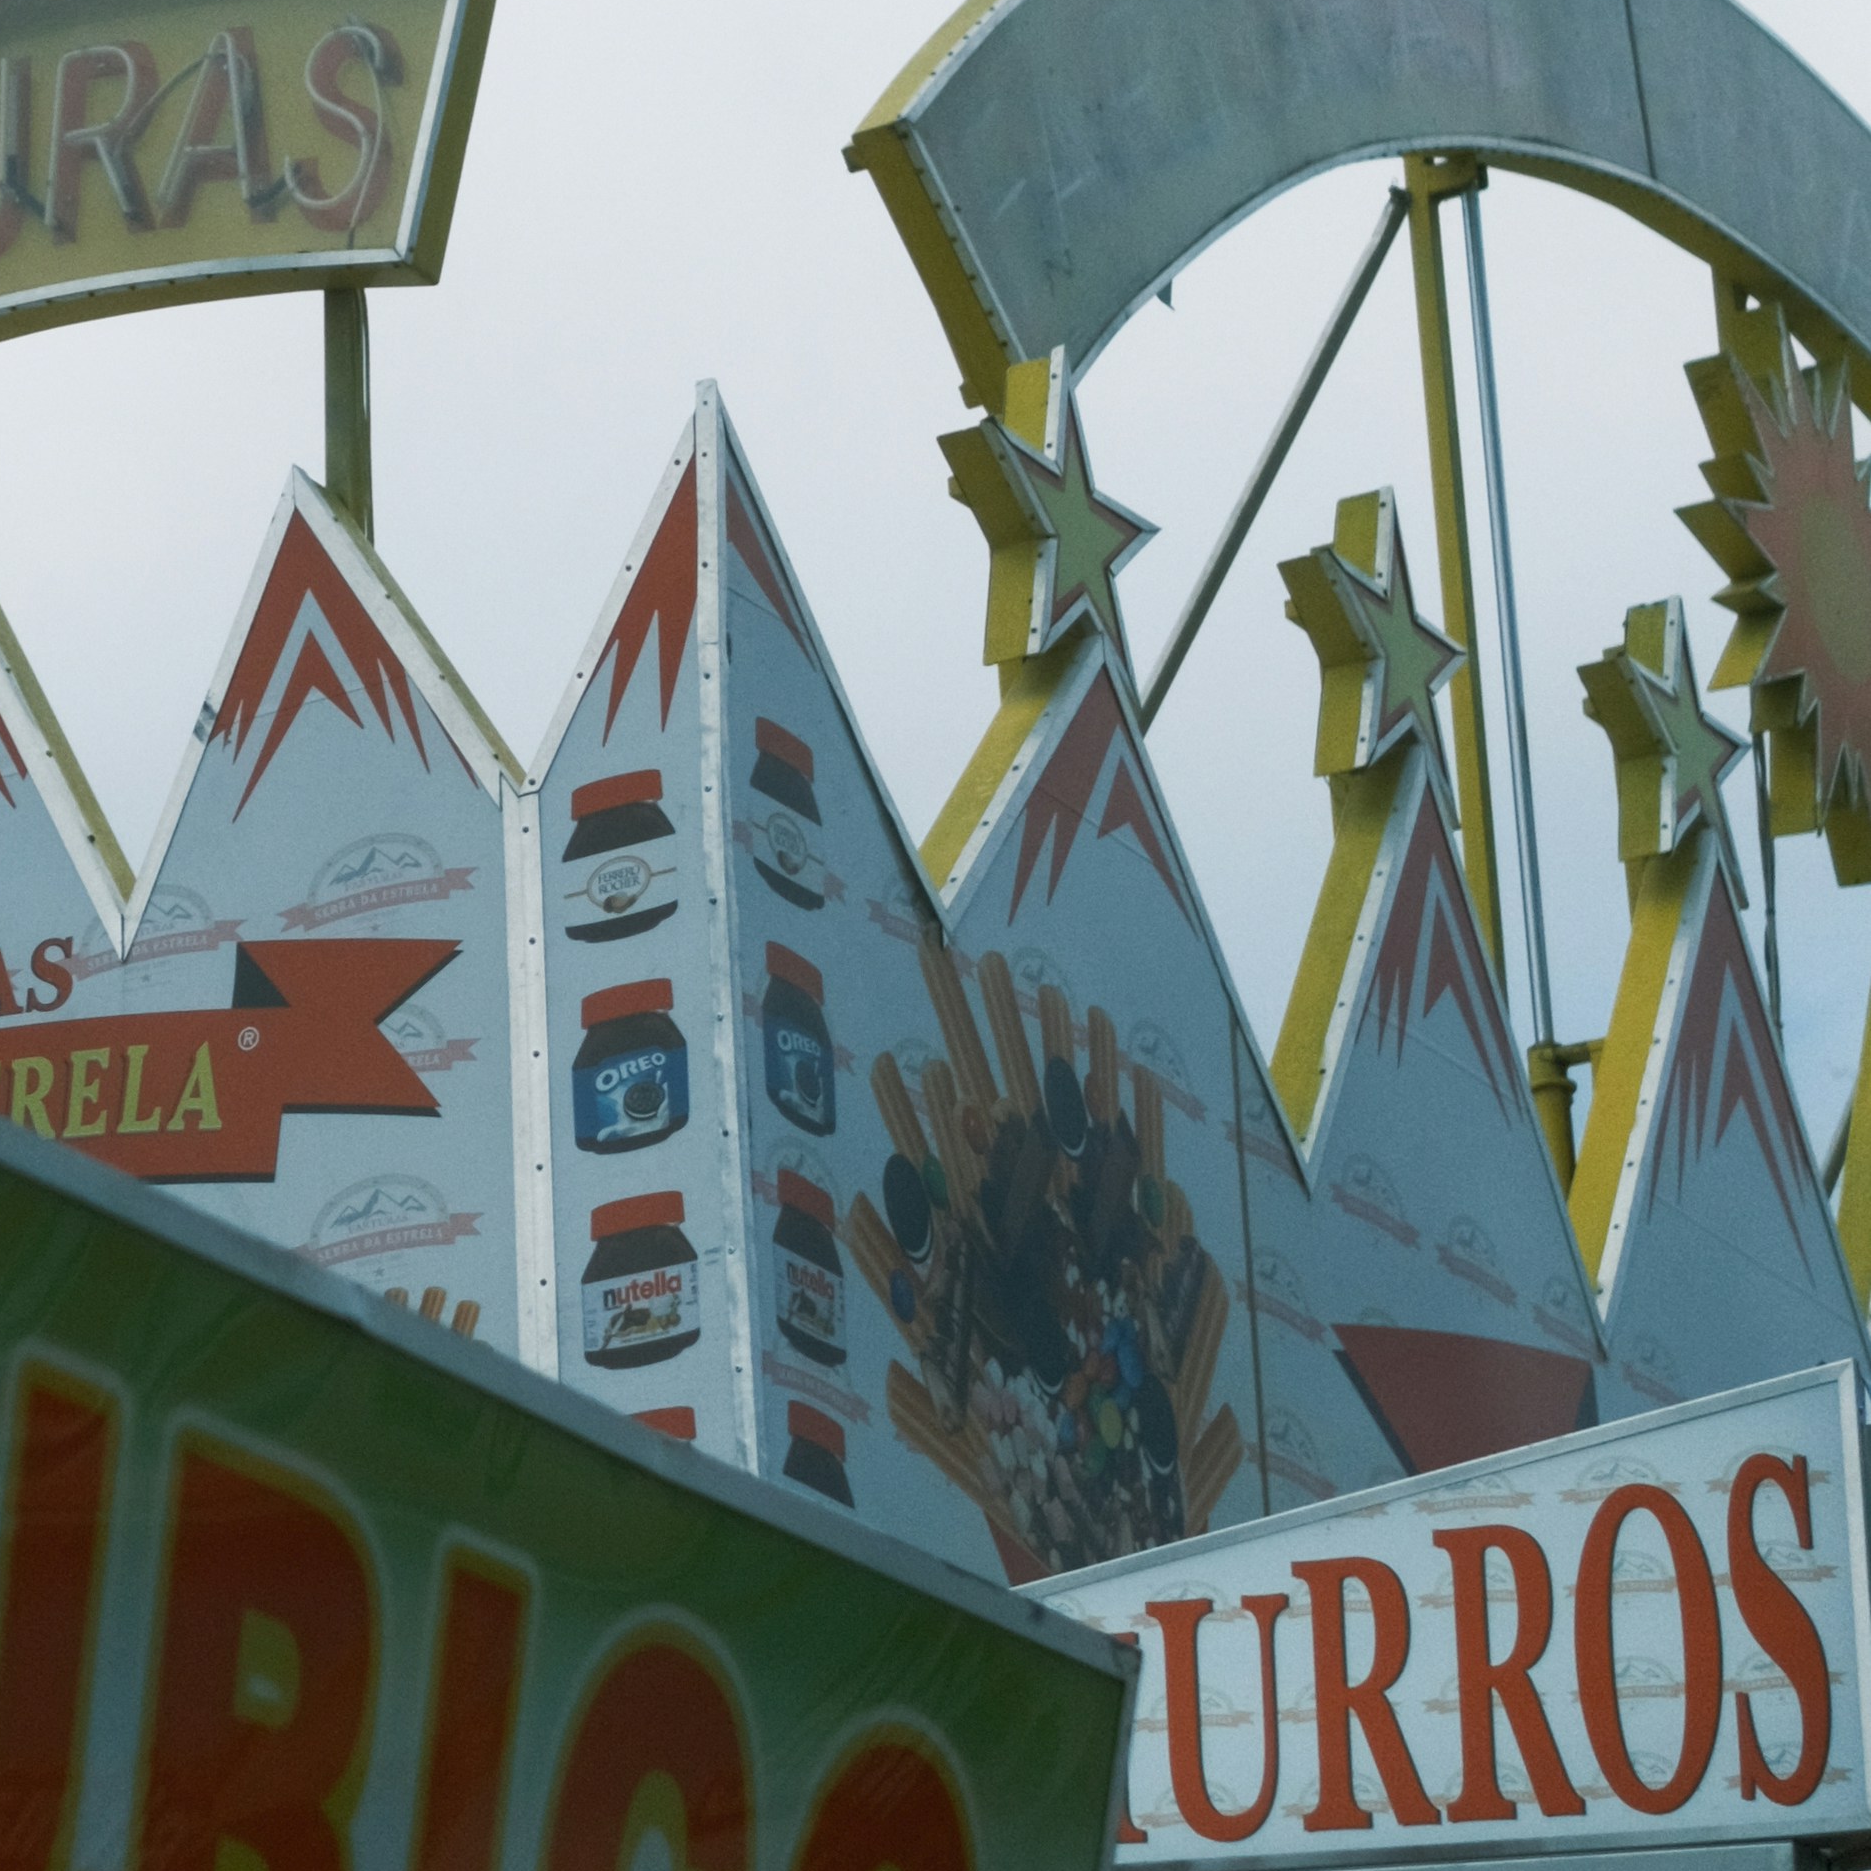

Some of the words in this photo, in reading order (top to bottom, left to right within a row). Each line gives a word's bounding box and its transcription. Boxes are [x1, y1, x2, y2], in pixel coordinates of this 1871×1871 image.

[595, 1052, 666, 1092] OREO
[603, 1270, 682, 1310] nutella
[1115, 1451, 1833, 1846] URROS
